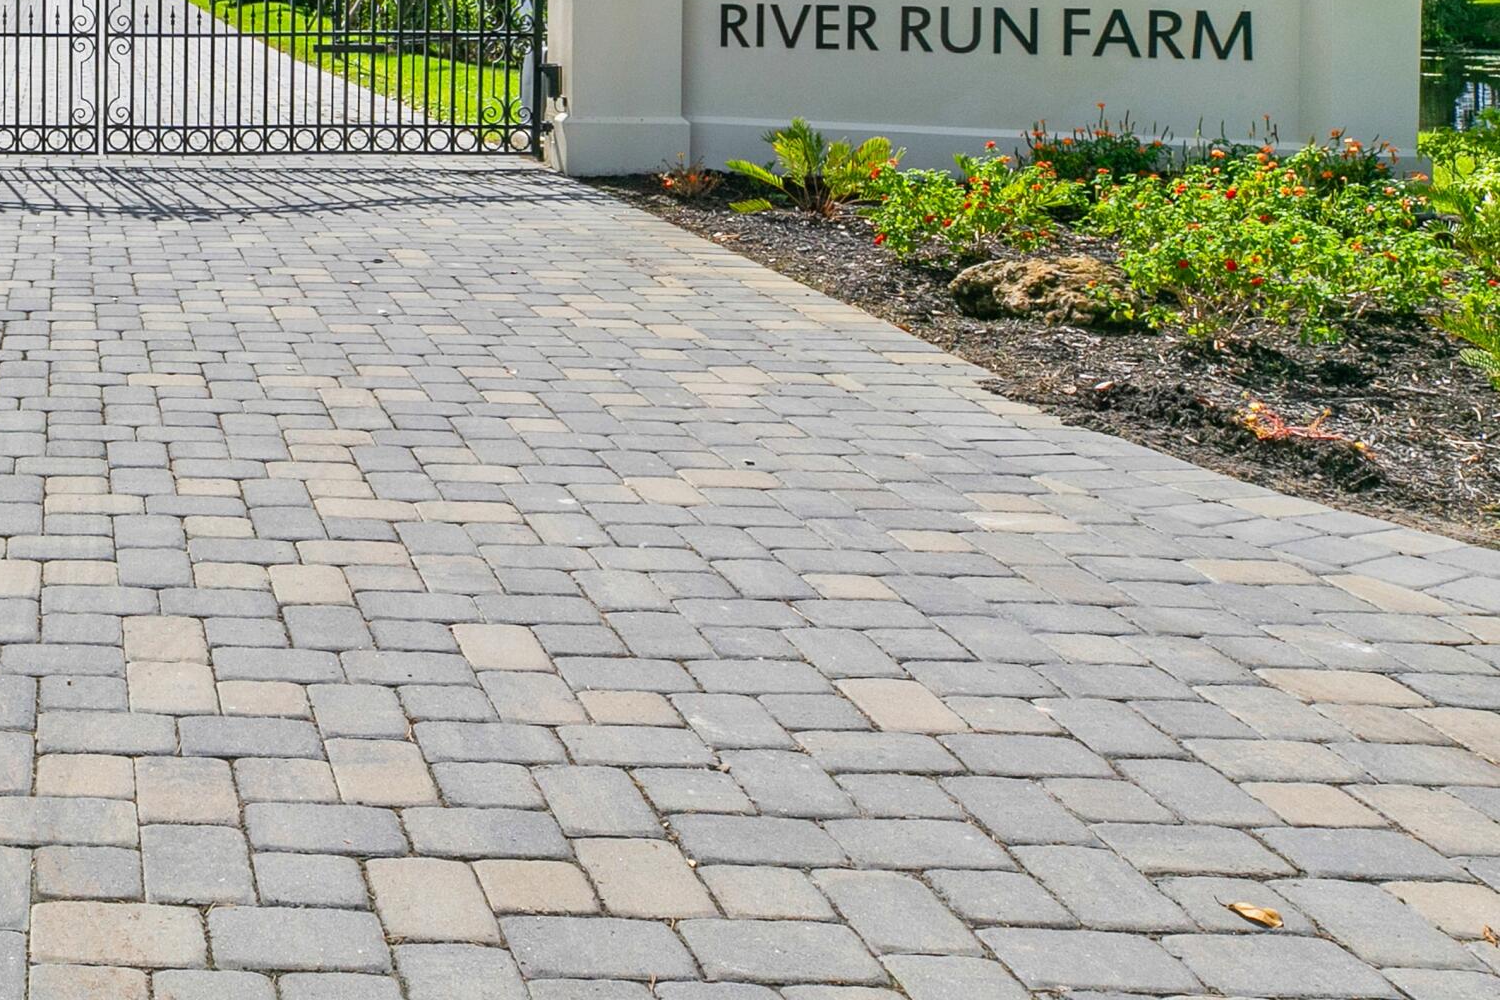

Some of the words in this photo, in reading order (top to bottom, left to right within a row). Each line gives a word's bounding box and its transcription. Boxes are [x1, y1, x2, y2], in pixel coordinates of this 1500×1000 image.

[719, 3, 879, 51] RIVER
[900, 6, 1040, 55] RUN
[1062, 8, 1254, 61] FARM
